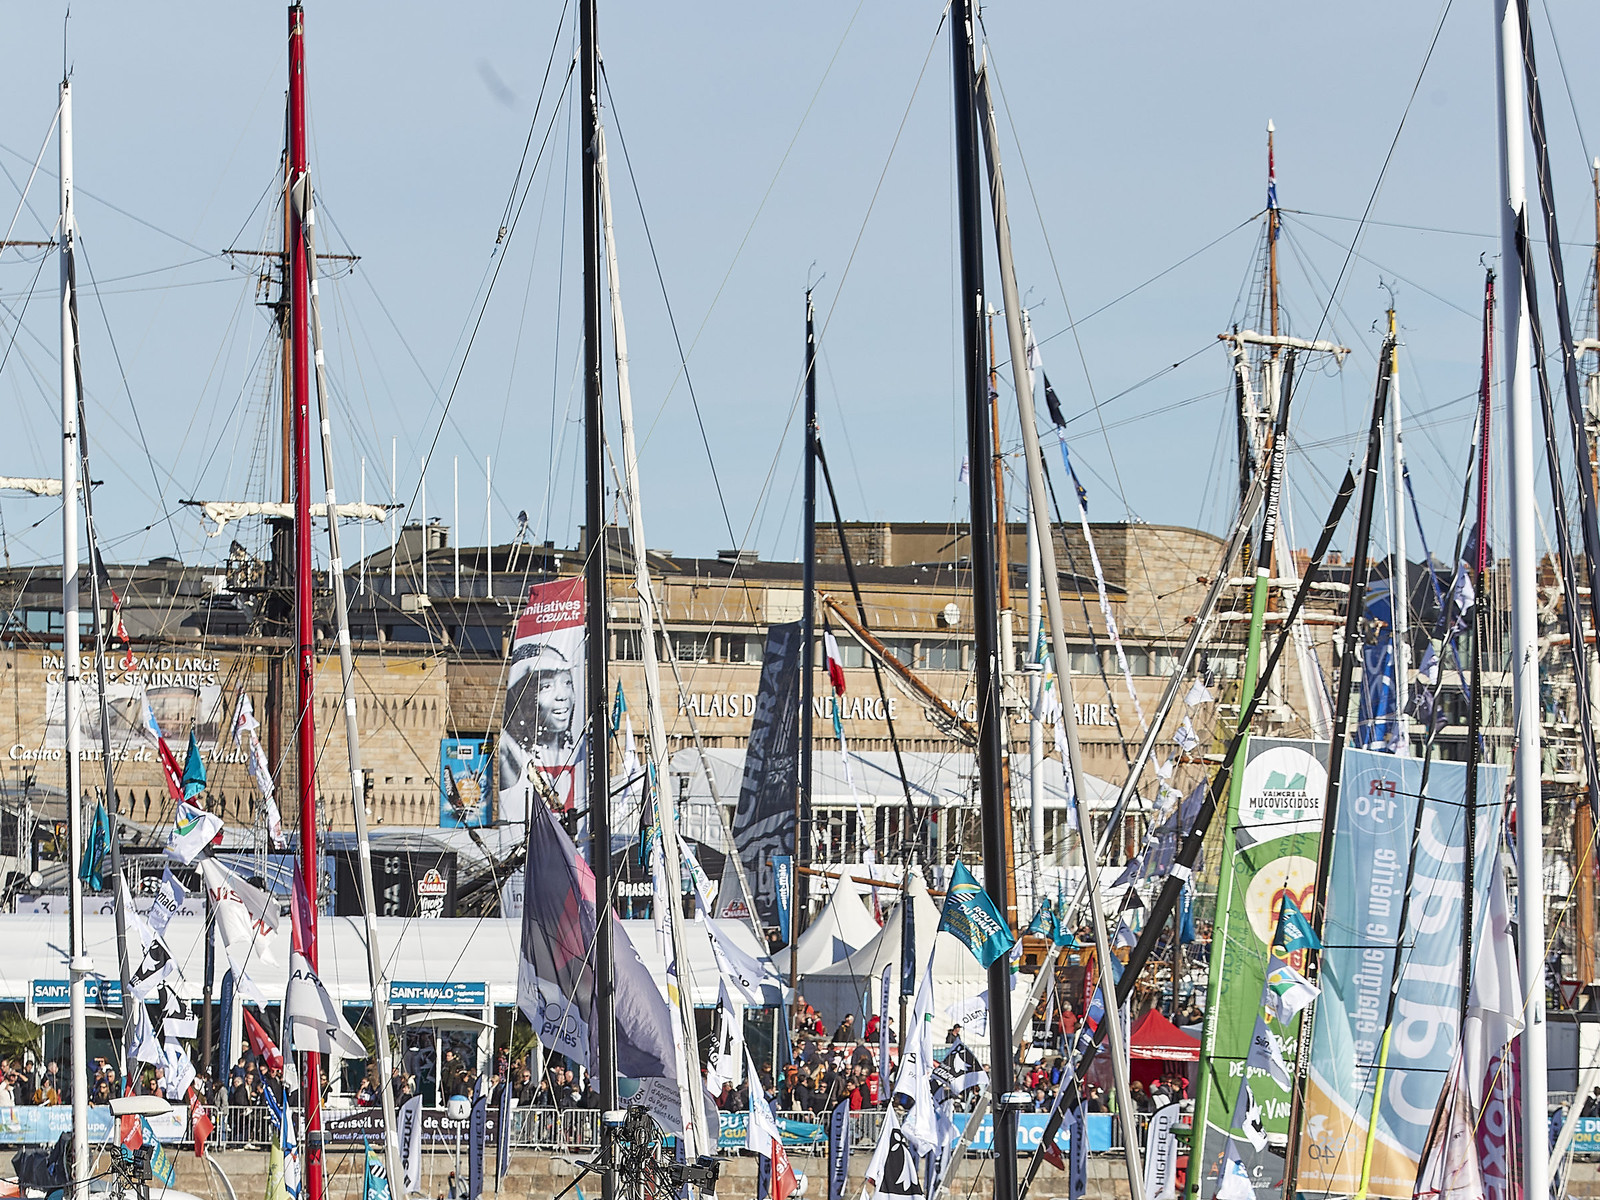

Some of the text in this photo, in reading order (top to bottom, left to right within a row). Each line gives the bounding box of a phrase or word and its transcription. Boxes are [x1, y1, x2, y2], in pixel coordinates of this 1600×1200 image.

[174, 658, 220, 672] LARGE
[678, 694, 739, 718] PALAIS
[841, 697, 898, 721] LARGE
[9, 744, 62, 761] Casino
[1249, 797, 1319, 808] MUCOVISCIDOSE
[957, 904, 997, 936] DU RHUM
[972, 905, 1002, 932] ROUTE
[35, 985, 98, 997] SAINT-LO
[391, 987, 454, 999] SAINT-MALO
[458, 1104, 464, 1115] A
[424, 1117, 438, 1129] de
[402, 1109, 413, 1167] SUZUKI
[1156, 1115, 1168, 1186] HIGHFIELD
